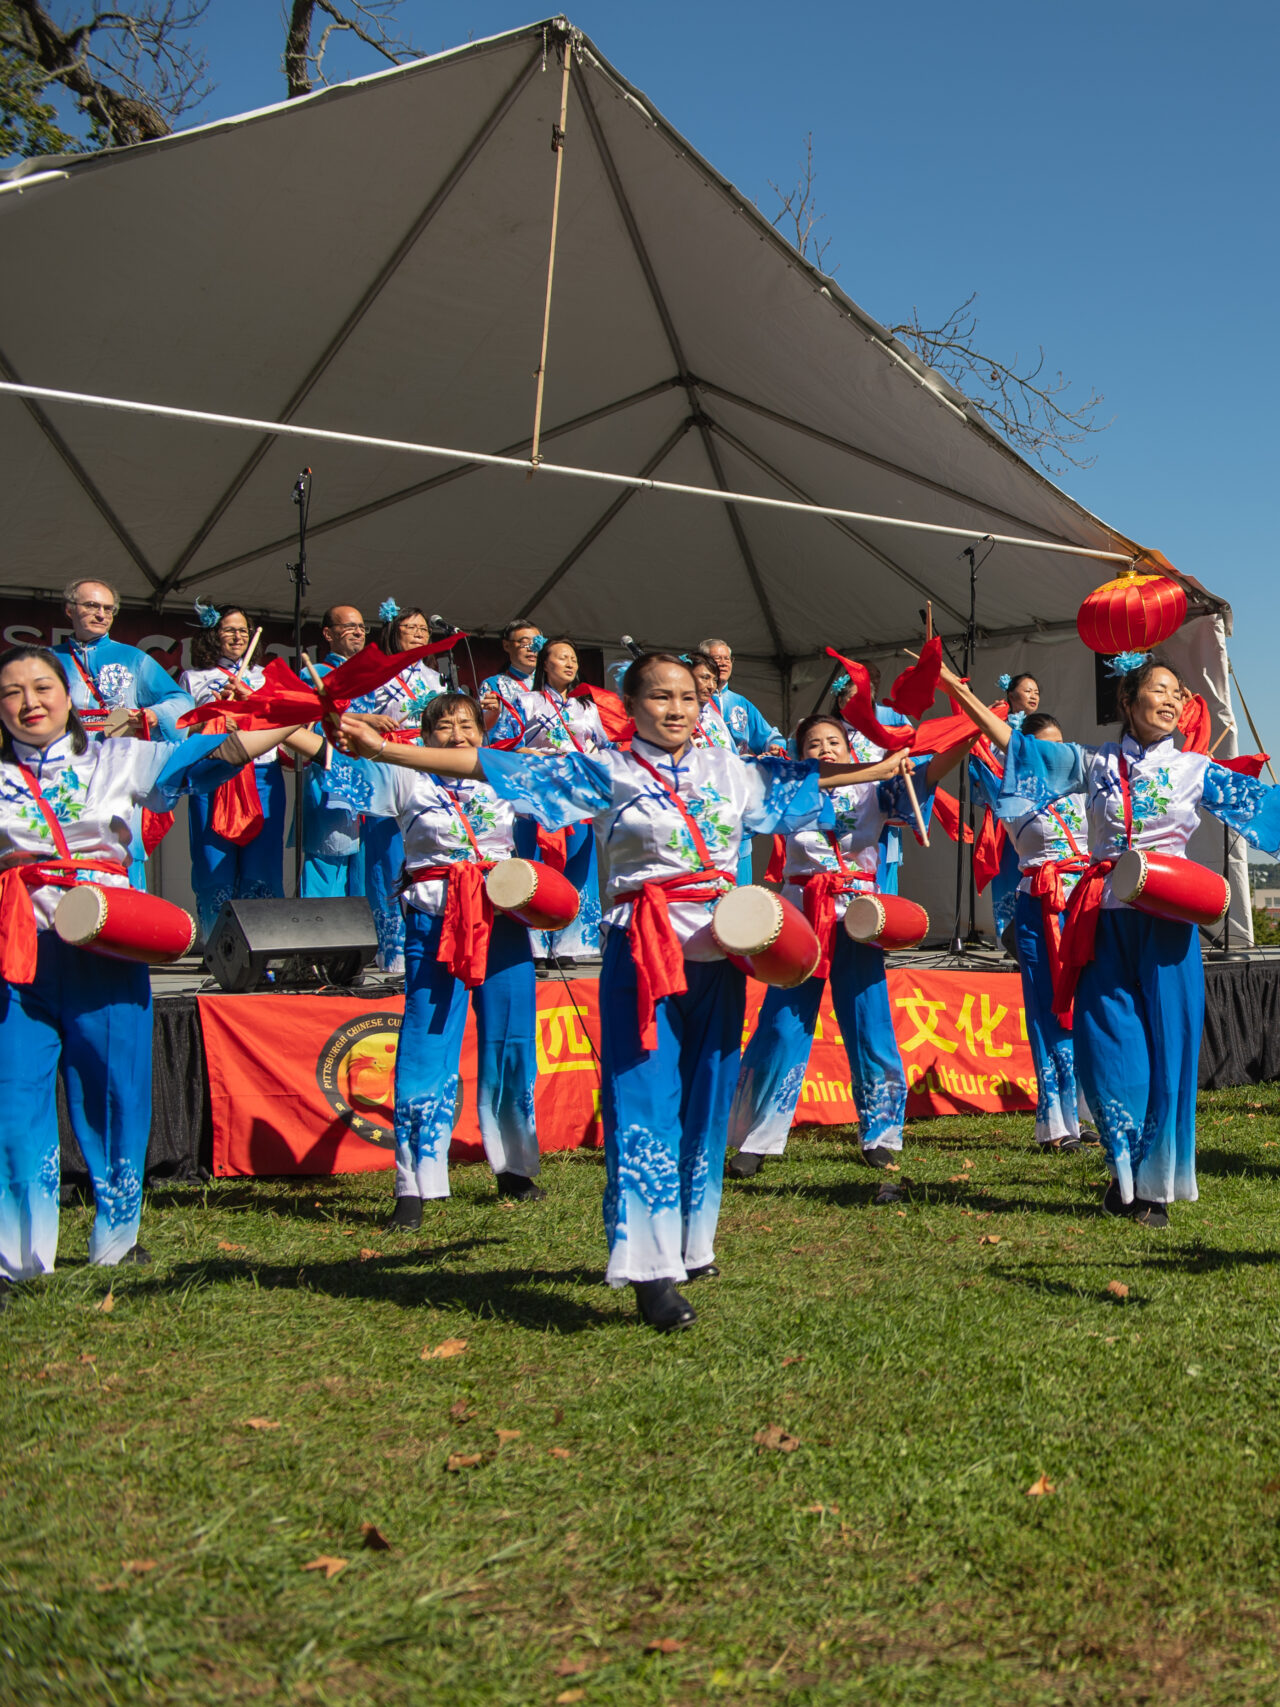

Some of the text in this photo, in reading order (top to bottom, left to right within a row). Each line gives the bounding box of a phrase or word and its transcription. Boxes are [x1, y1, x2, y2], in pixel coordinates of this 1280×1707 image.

[322, 1034, 349, 1090] PITTSBURGH
[346, 1018, 384, 1038] CHINESE
[895, 988, 1013, 1058] 文化
[907, 1064, 1012, 1096] Cultural
[1015, 1076, 1037, 1096] ce
